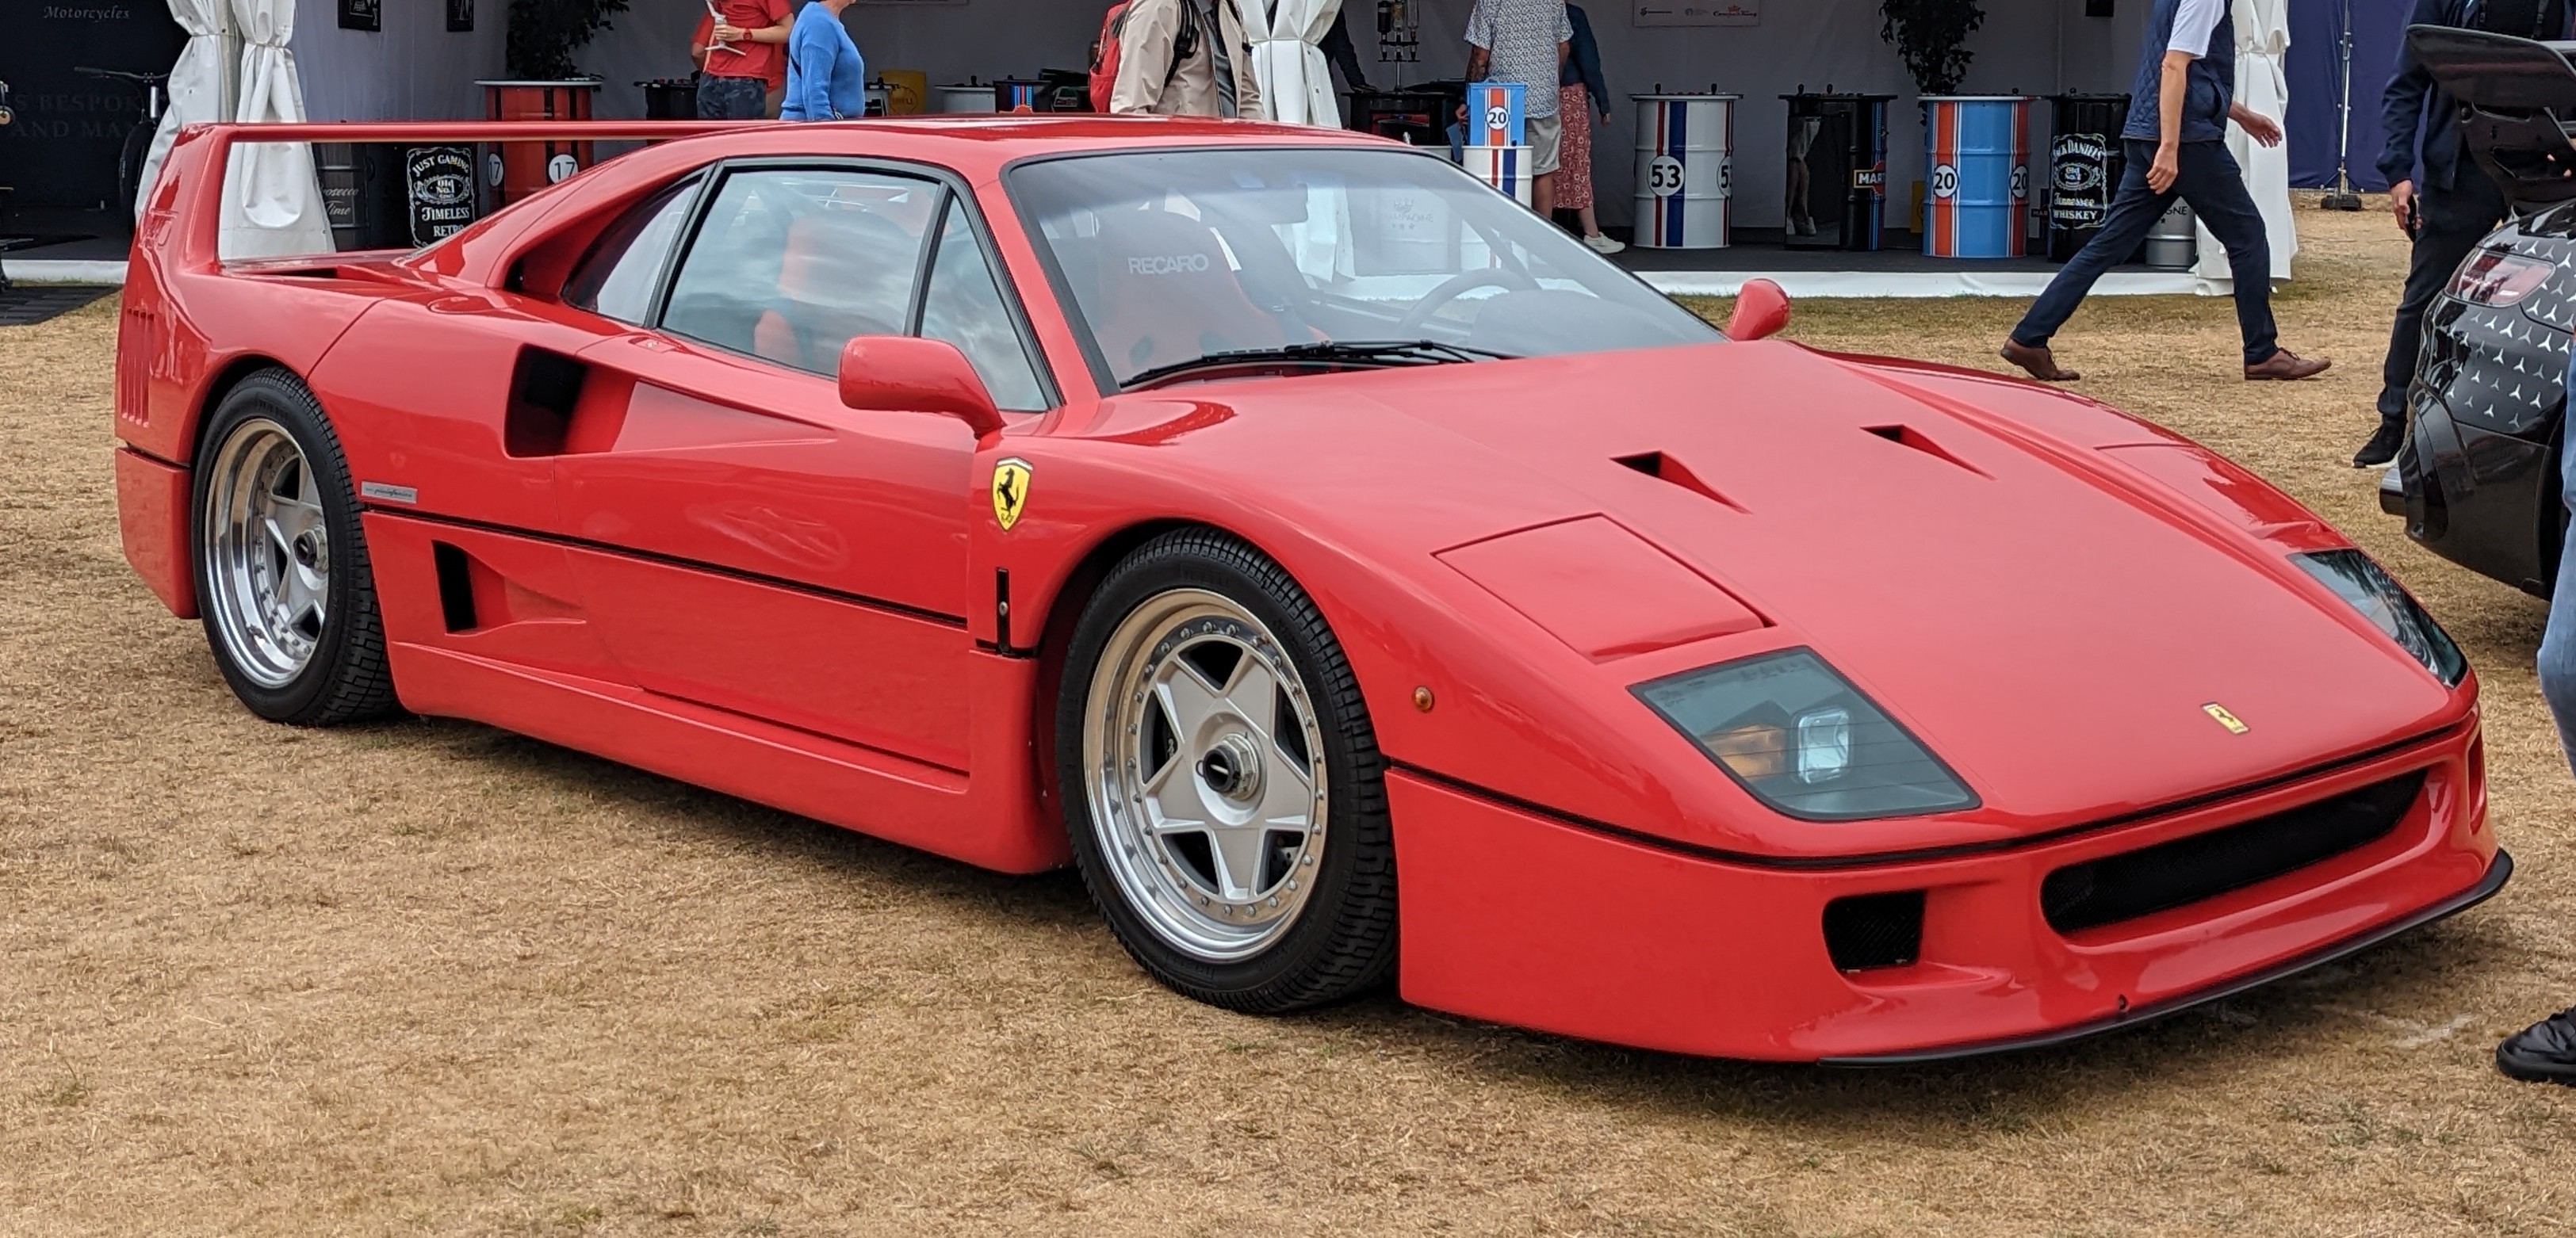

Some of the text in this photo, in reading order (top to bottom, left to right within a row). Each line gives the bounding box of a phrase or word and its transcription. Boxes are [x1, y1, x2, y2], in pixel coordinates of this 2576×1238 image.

[43, 6, 131, 23] Motorcycles
[1488, 112, 1506, 124] 20
[412, 155, 469, 177] JUST GAMING
[489, 161, 500, 179] 17
[554, 162, 576, 180] 17
[1651, 164, 1681, 188] 53
[1935, 173, 1955, 190] 20
[2012, 173, 2027, 190] 20
[422, 207, 469, 221] TIMELESS
[2054, 209, 2098, 220] WHISKEY
[1128, 253, 1209, 274] RECARO
